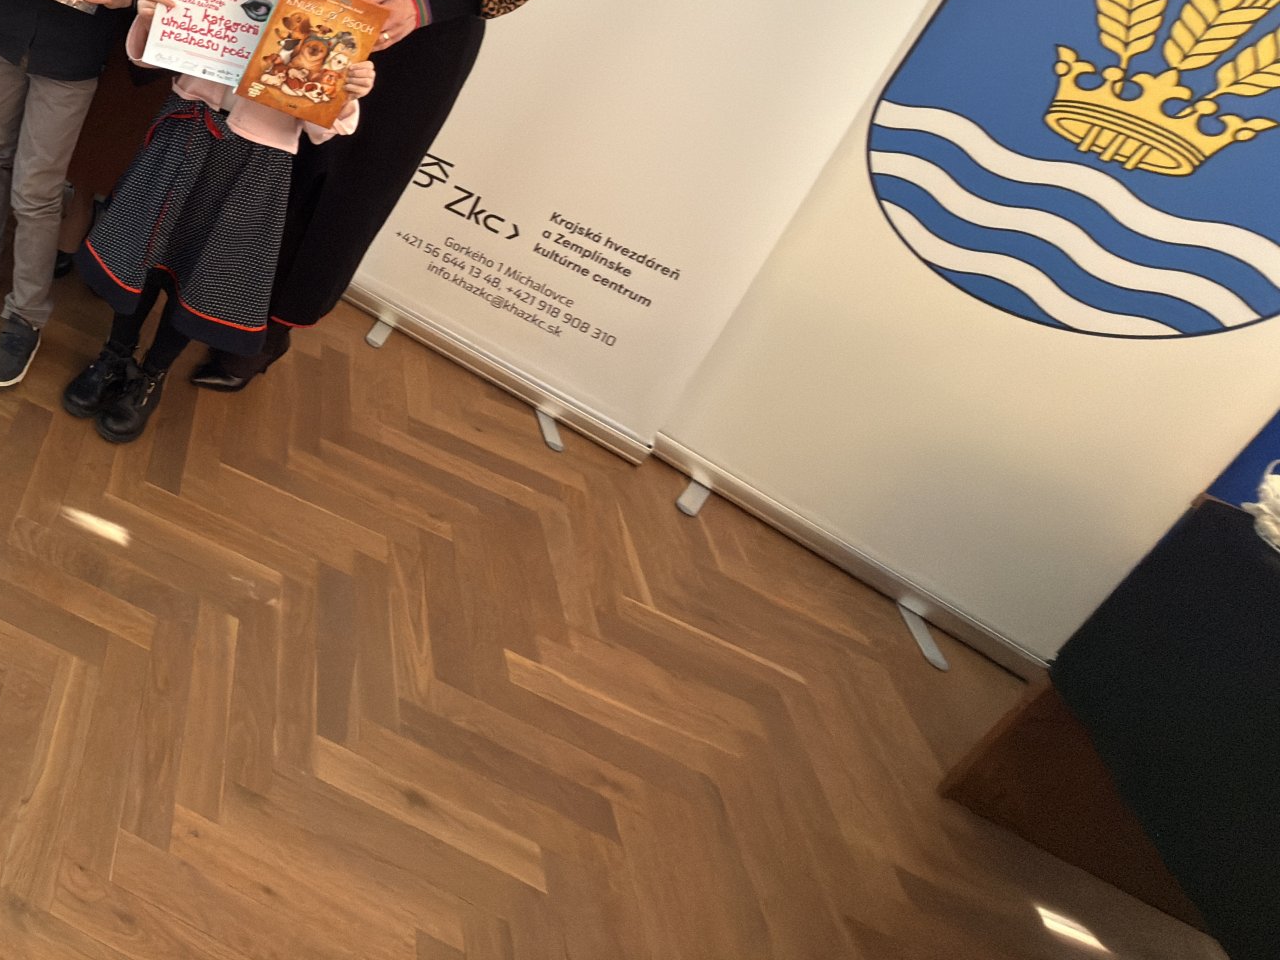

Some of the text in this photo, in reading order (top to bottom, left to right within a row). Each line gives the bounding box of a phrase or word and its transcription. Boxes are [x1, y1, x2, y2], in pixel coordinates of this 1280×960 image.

[160, 29, 219, 52] prednesu
[220, 46, 252, 60] poéz
[161, 16, 238, 44] umeleckého
[444, 236, 494, 268] Gorkého
[505, 266, 575, 309] Michalovce
[532, 242, 652, 307] kultúrne centrum
[542, 229, 632, 278] a Zemplínske
[549, 211, 681, 281] Krajská hvezdáreň
[395, 229, 423, 250] +421
[424, 243, 440, 258] 56
[441, 250, 466, 272] 644
[469, 263, 482, 280] 13
[505, 282, 537, 306] +421
[537, 299, 560, 319] 918
[562, 312, 591, 334] 908
[592, 327, 617, 348] 310
[427, 260, 563, 338] info.khazkc@khazkc.sk
